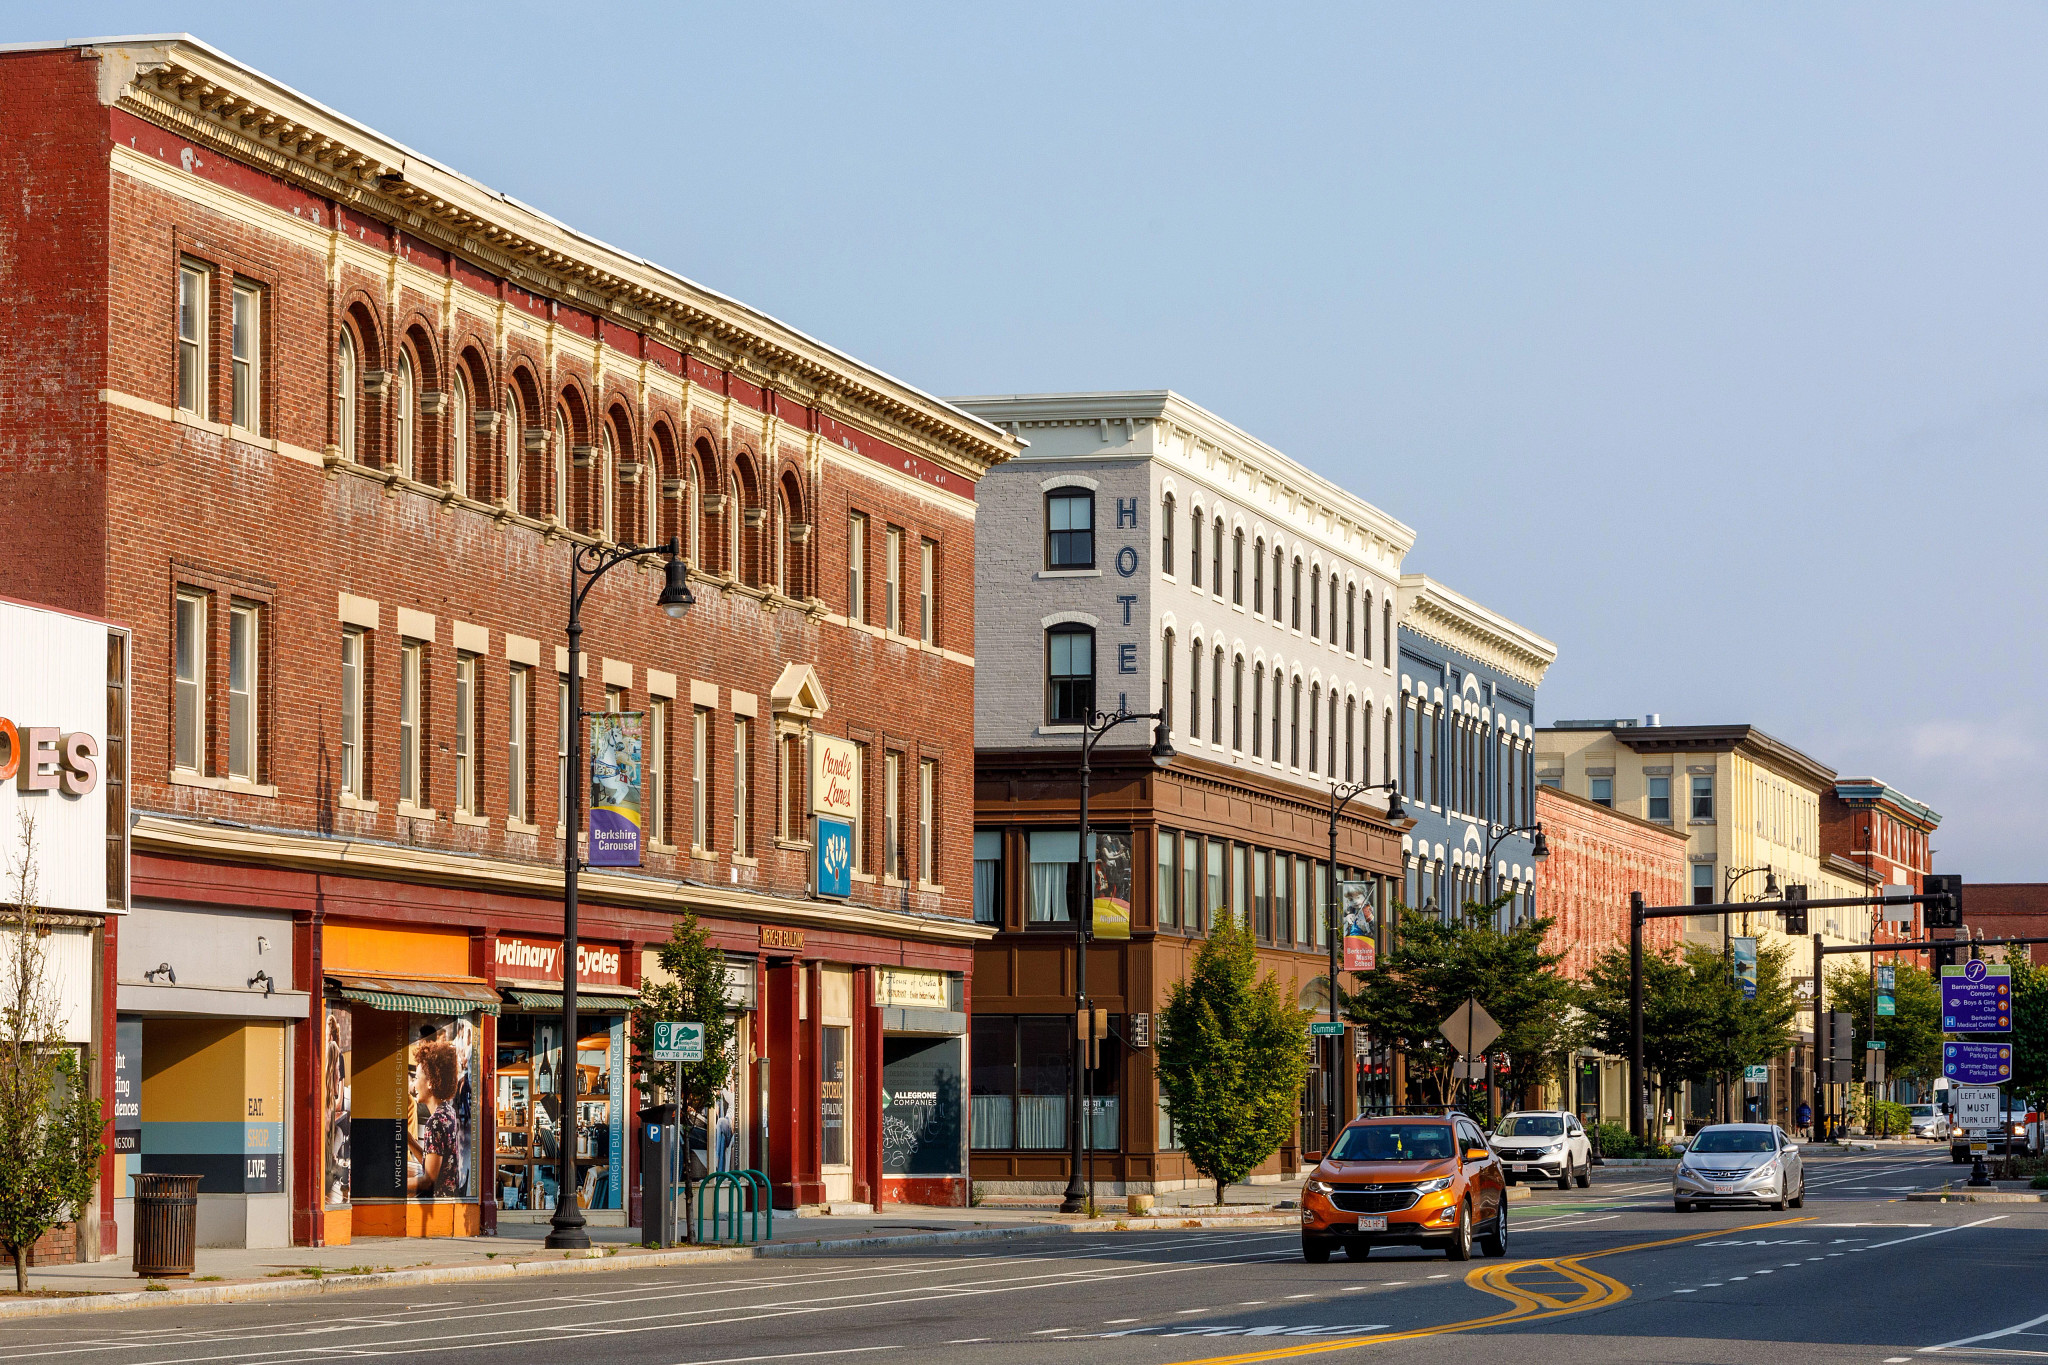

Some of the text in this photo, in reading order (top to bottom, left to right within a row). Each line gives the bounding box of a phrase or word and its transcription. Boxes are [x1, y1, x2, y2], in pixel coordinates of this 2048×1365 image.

[1116, 497, 1138, 724] HOTEL
[822, 748, 852, 780] Candle
[823, 776, 851, 808] Lanes
[594, 830, 637, 840] Berkshire
[598, 840, 637, 850] Carousel
[1100, 914, 1127, 924] Nightlife
[762, 928, 805, 948] WRIGHT BUILDING
[576, 946, 619, 976] Cycles
[919, 973, 936, 987] India
[1313, 1025, 1336, 1033] Summer
[248, 1098, 263, 1116] EAT.
[248, 1129, 270, 1147] SHOP.
[650, 1126, 658, 1139] P
[122, 1137, 134, 1148] SOON
[247, 1160, 267, 1178] LIVE.
